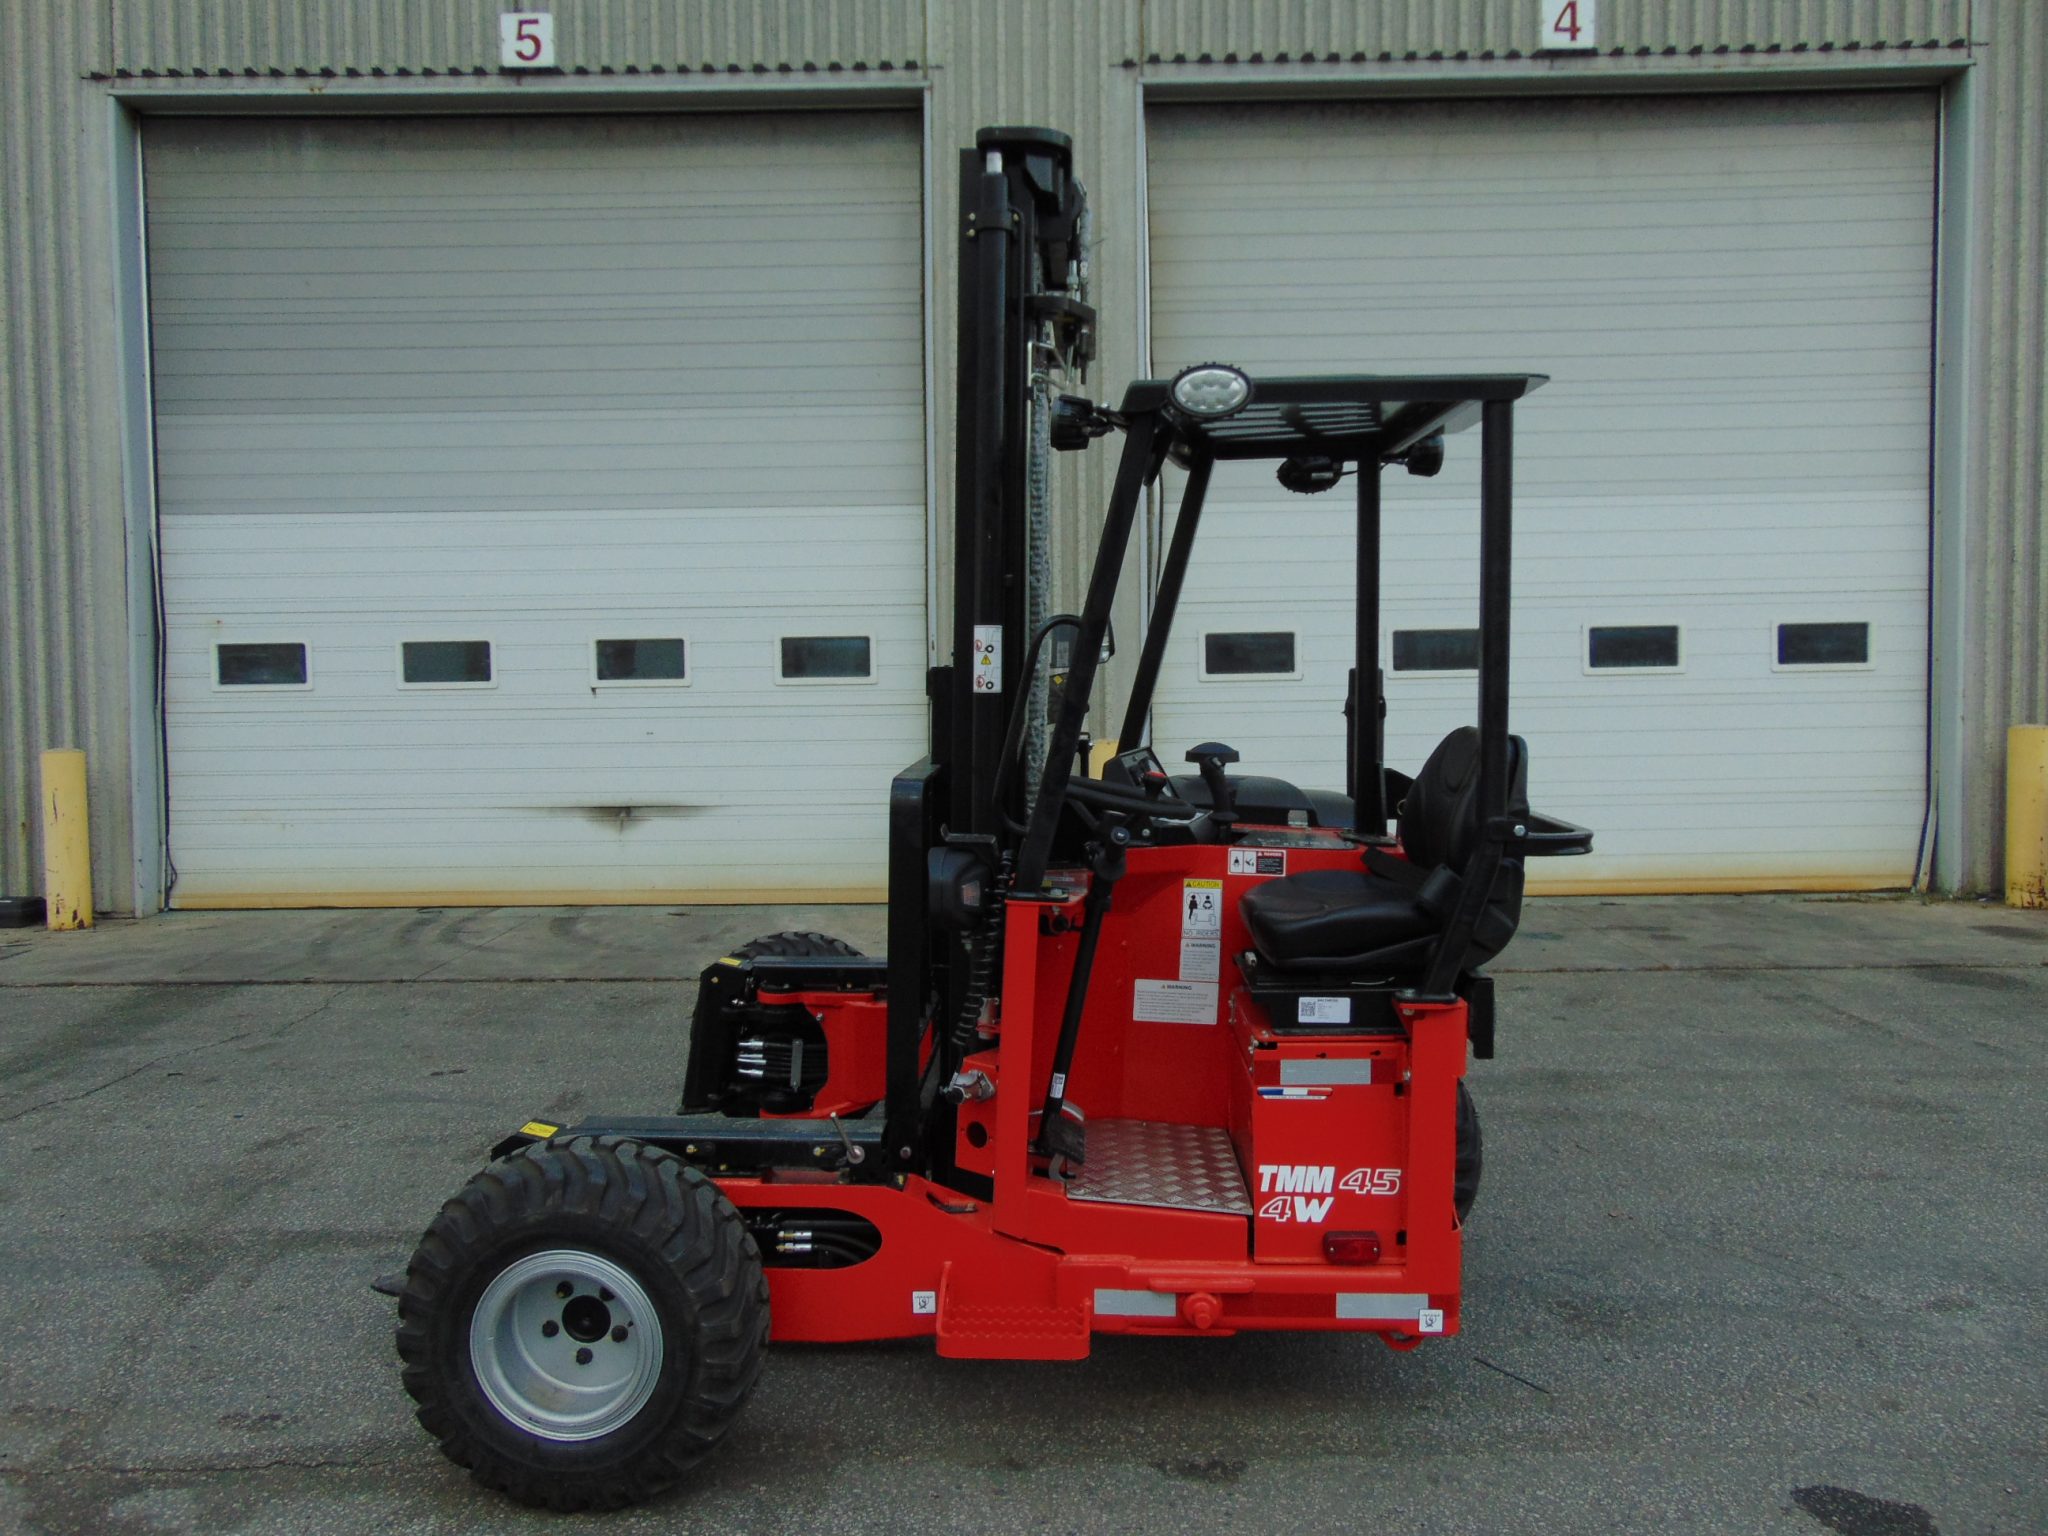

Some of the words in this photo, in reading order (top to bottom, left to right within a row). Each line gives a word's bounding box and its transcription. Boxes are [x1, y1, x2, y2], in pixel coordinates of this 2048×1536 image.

[1554, 0, 1581, 41] 4
[515, 18, 542, 61] 5
[1192, 880, 1220, 888] CAUTION
[1258, 1164, 1335, 1193] TMM
[1338, 1168, 1402, 1195] 45
[1259, 1196, 1335, 1223] 4W
